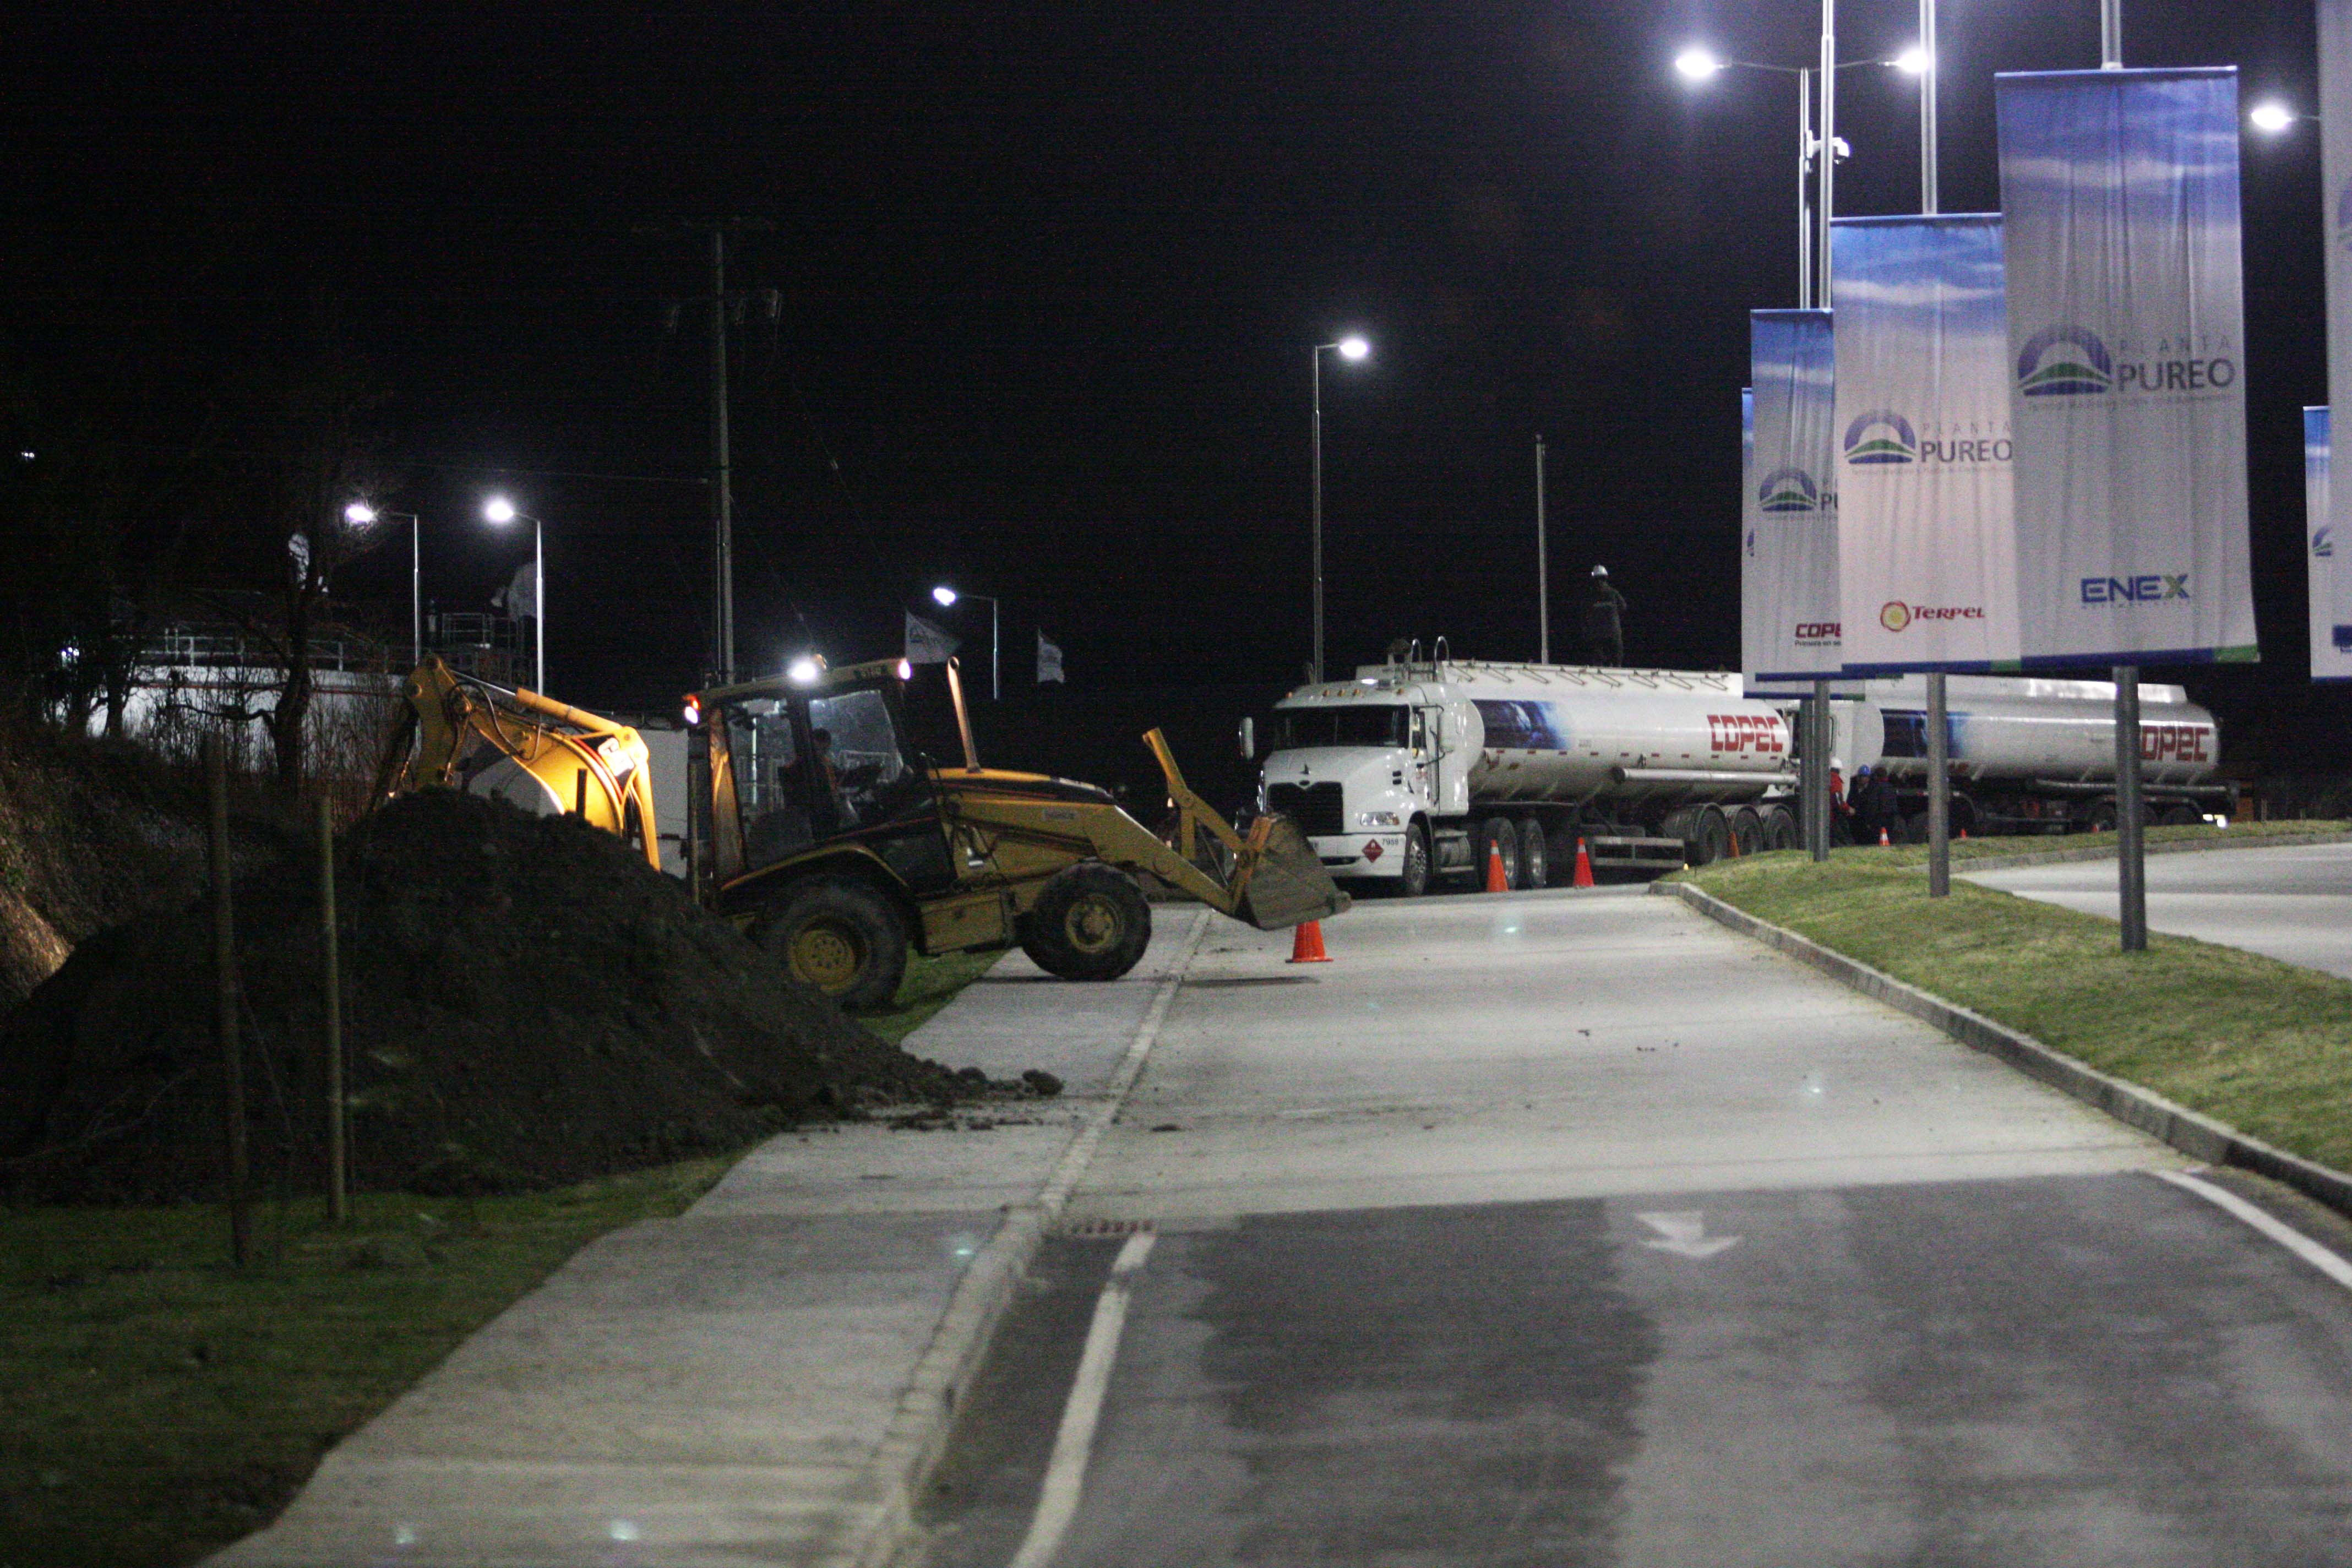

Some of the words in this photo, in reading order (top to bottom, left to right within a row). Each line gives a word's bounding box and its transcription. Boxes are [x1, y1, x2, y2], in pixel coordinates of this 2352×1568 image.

[2117, 358, 2235, 391] PUREO
[1920, 439, 2012, 462] PUREO
[2081, 574, 2189, 603] ENEX
[1707, 715, 1783, 752] COPEC
[2140, 726, 2210, 761] OPEC
